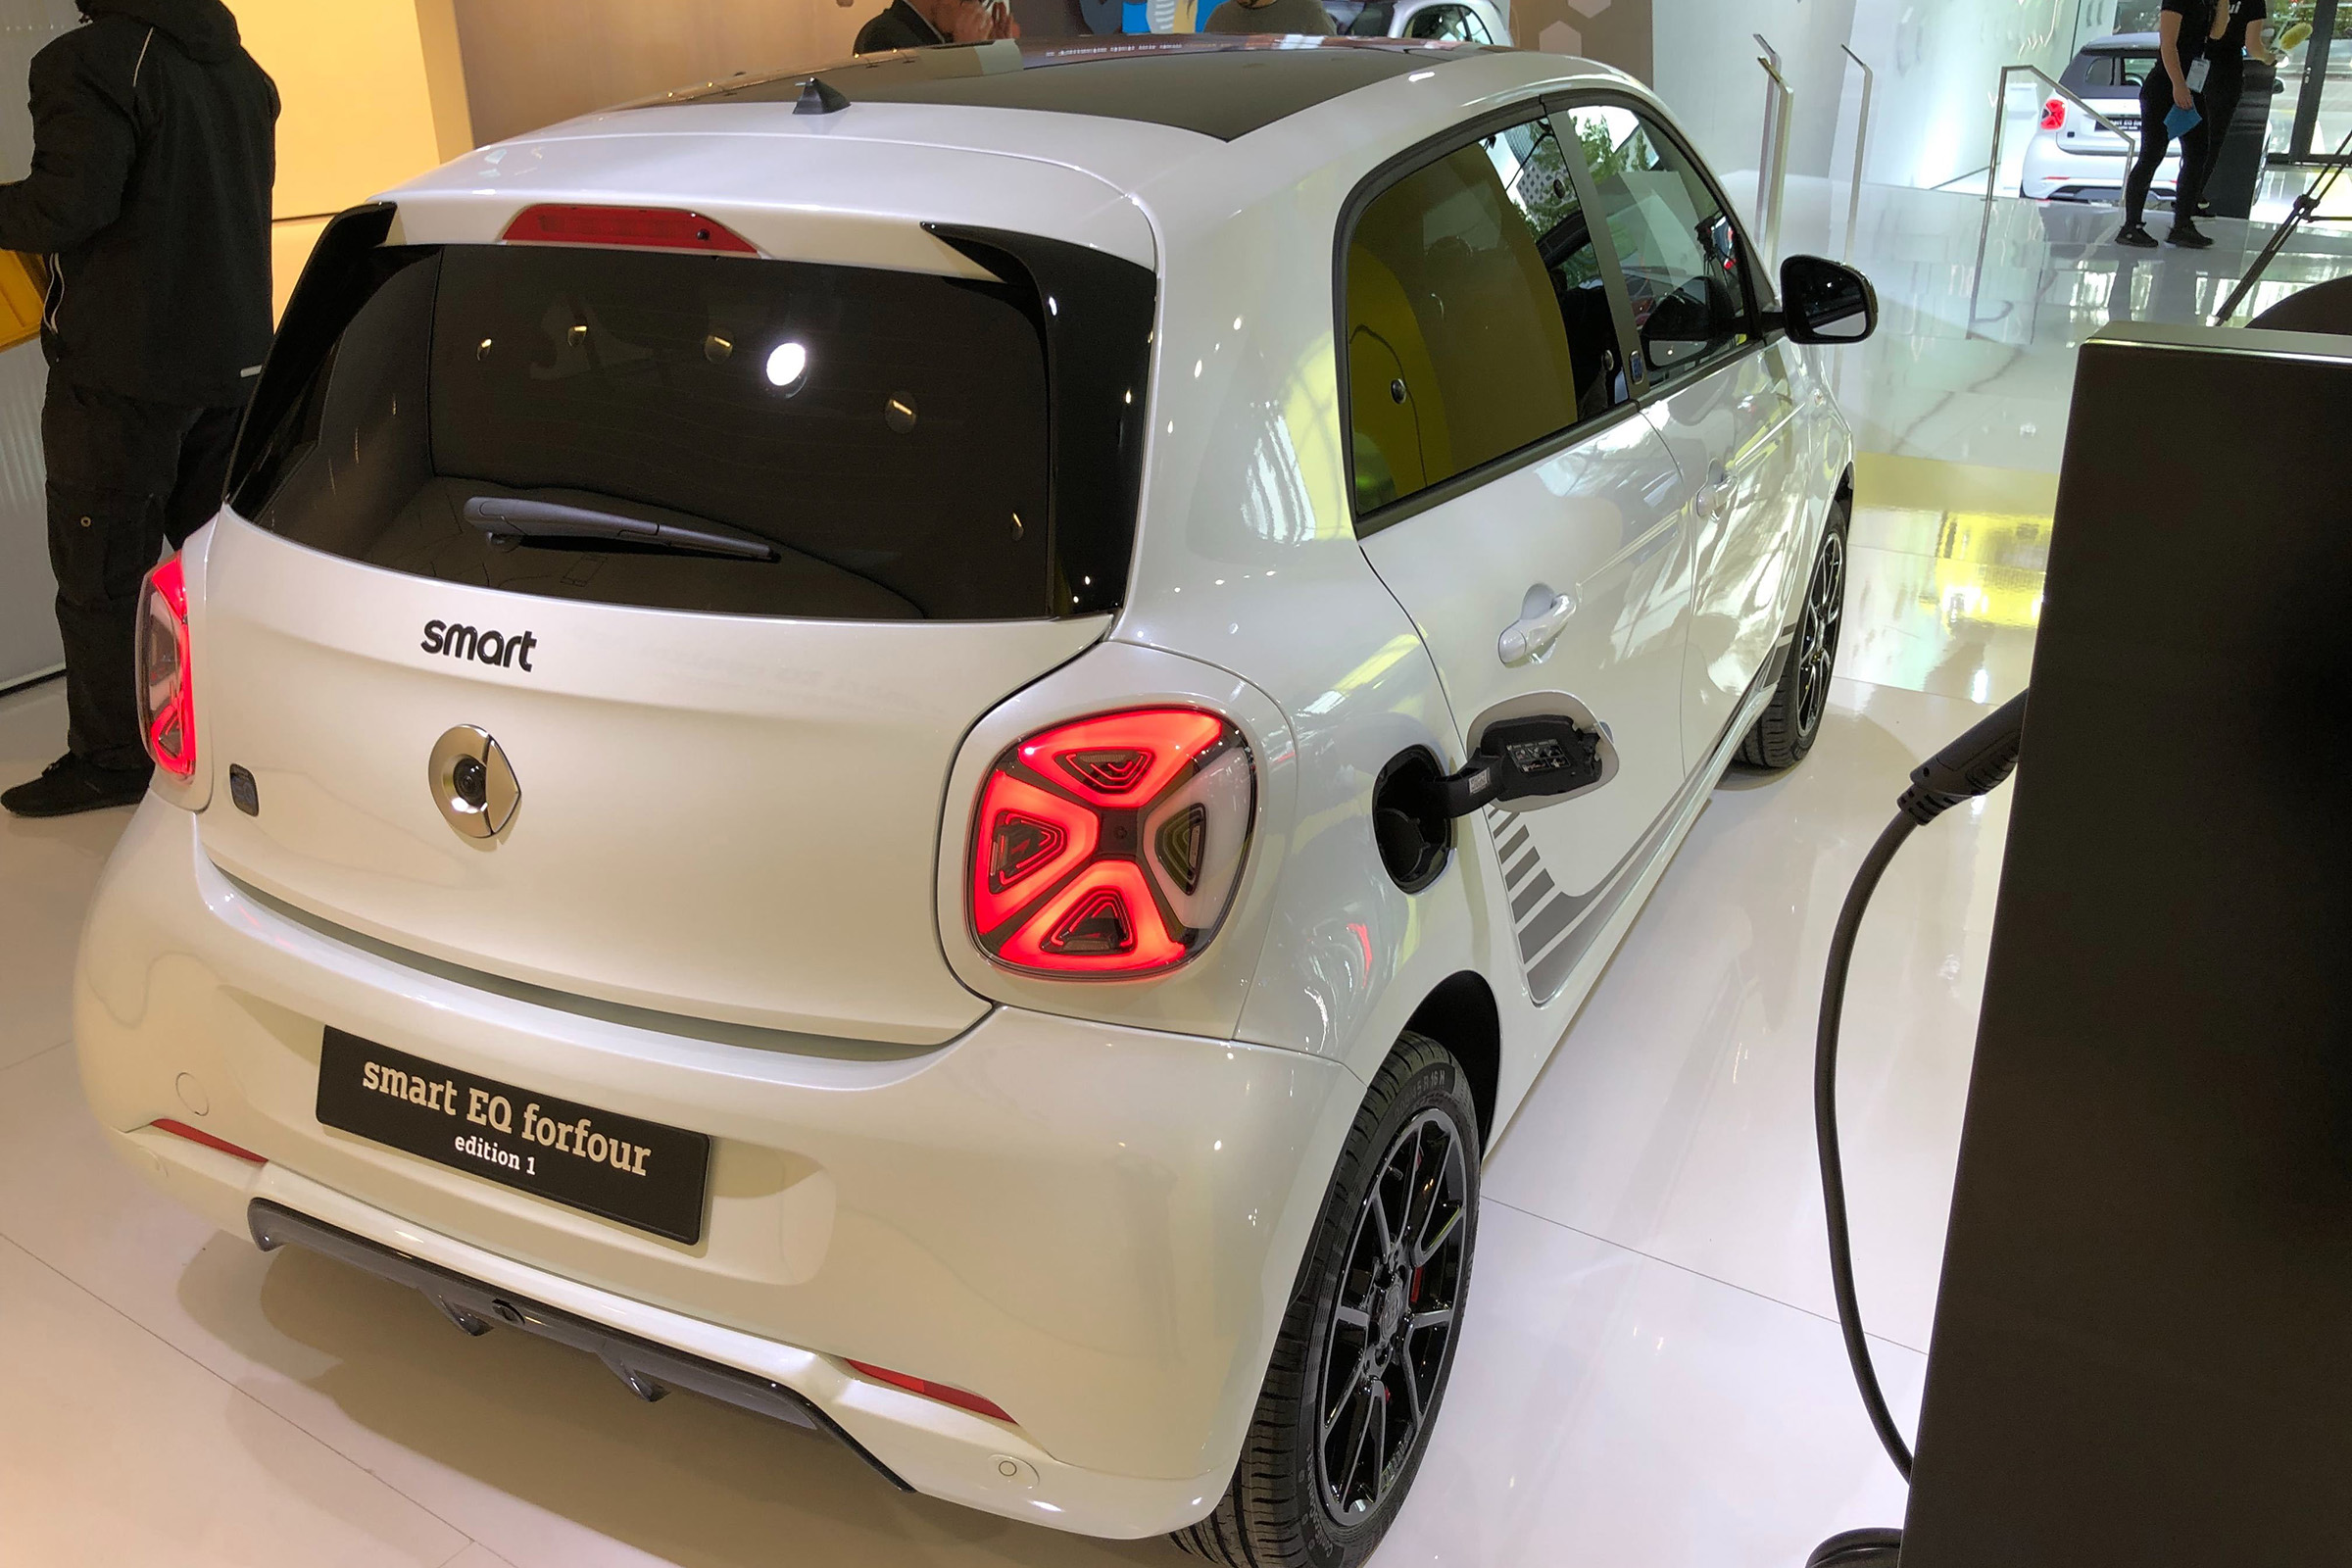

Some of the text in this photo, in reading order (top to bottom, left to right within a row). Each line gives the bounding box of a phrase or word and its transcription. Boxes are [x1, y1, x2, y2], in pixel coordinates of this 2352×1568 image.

[420, 619, 537, 672] smart
[363, 1060, 652, 1176] smart EQ forfour
[455, 1135, 537, 1175] edition 1
